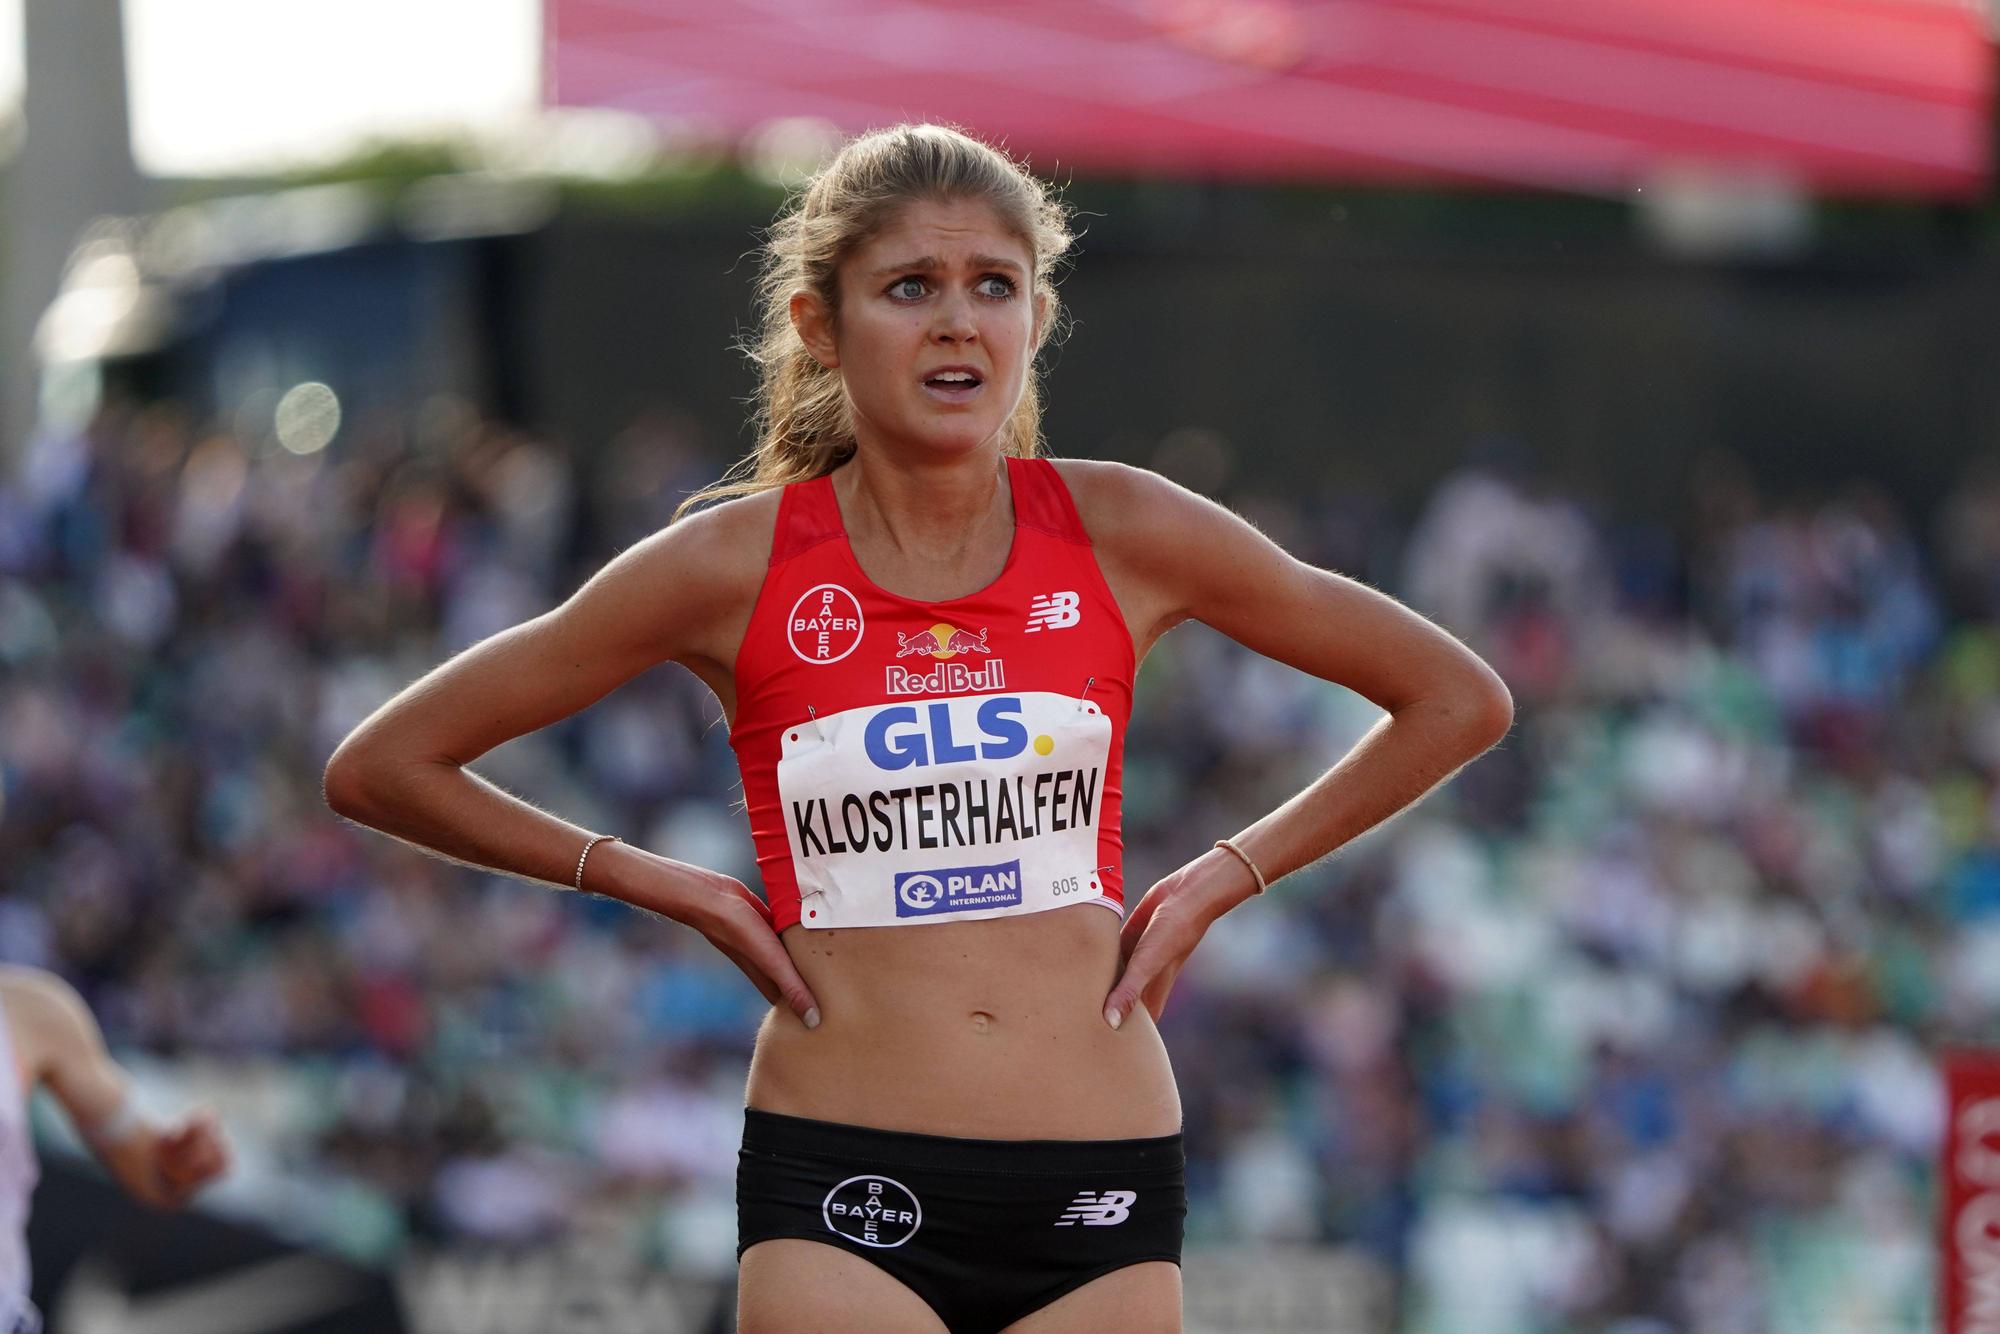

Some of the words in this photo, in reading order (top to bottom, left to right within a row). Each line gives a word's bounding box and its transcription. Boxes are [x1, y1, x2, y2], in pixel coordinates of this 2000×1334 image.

[794, 618, 857, 631] BAYER
[817, 591, 834, 658] BAYER
[885, 662, 946, 695] Red
[948, 658, 1005, 691] Bull
[792, 767, 1097, 858] KLOSTERHALFEN
[948, 870, 1017, 896] PLAN
[1052, 876, 1079, 897] 805
[949, 893, 1017, 906] INTERNATIONAL
[832, 1202, 914, 1225] BAYER
[863, 1182, 884, 1244] BAYER
